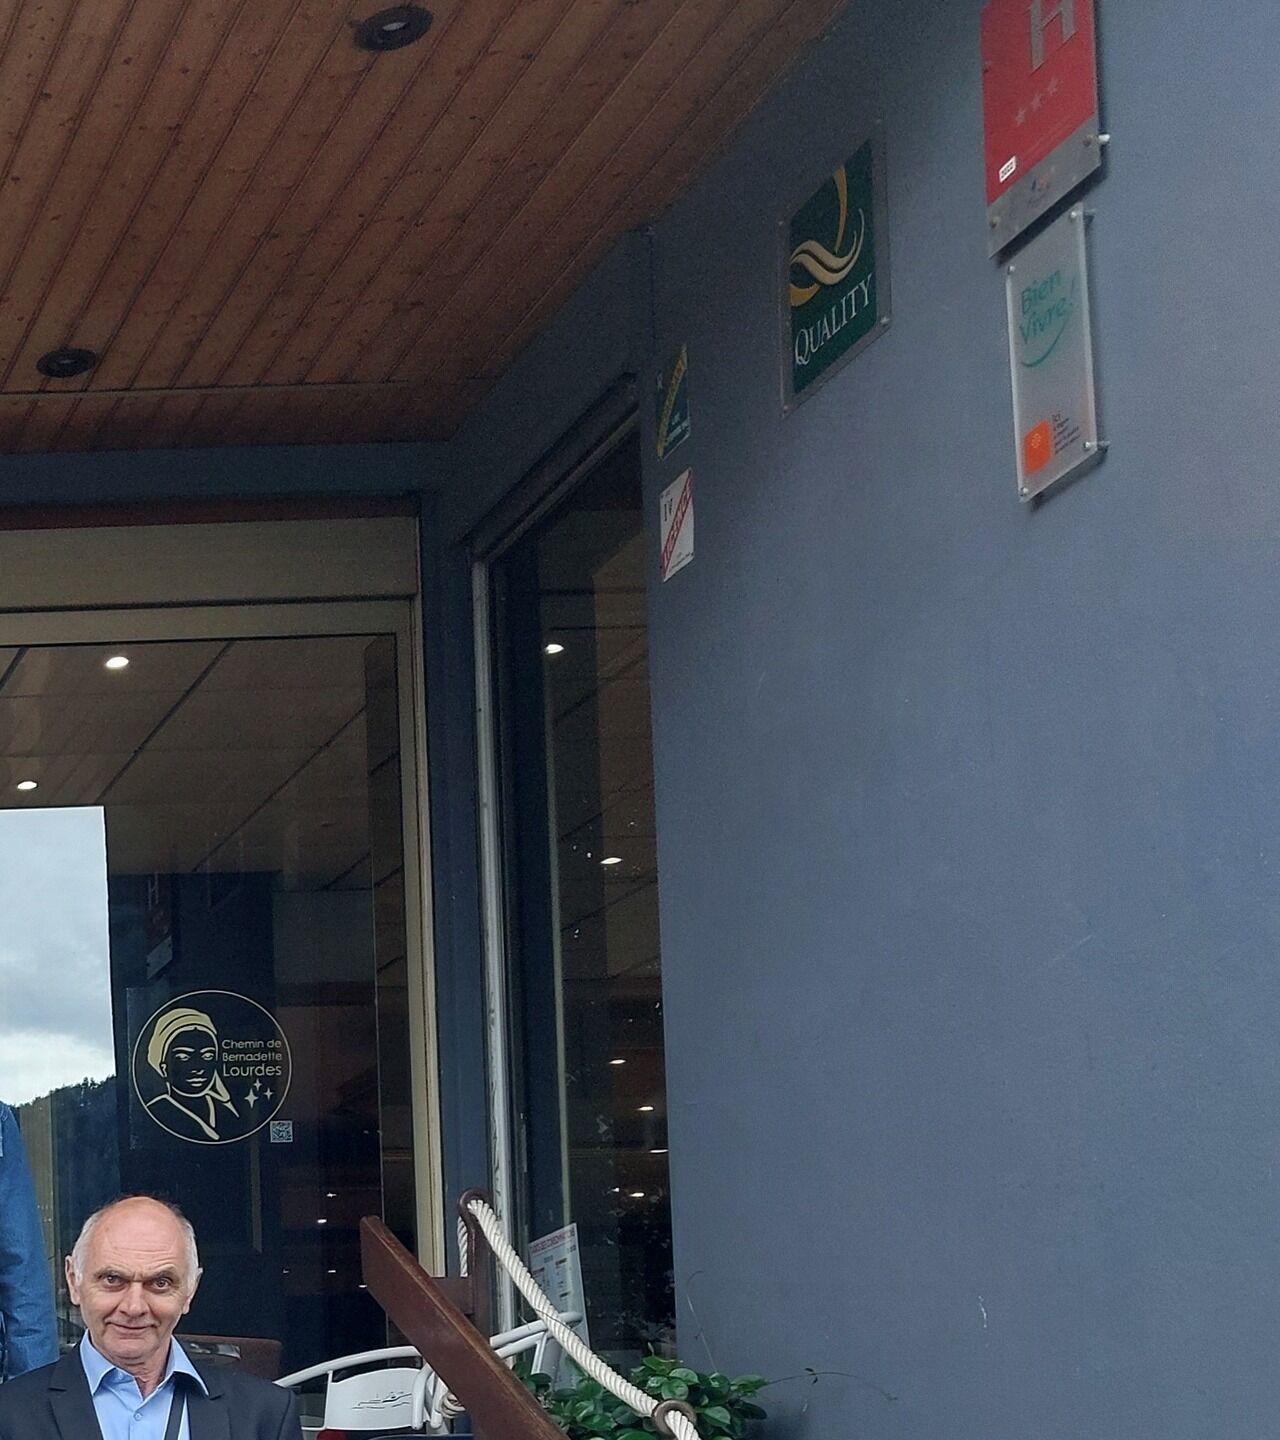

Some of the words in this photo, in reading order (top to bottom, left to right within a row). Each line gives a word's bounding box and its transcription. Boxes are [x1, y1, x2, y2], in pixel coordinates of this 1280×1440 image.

[1024, 0, 1078, 75] H
[1022, 271, 1061, 317] Bien
[795, 273, 872, 365] QUALITY
[222, 1039, 264, 1049] Chemin
[267, 1039, 281, 1048] de
[222, 1052, 282, 1061] Bernadette
[223, 1063, 282, 1077] Lourdes
